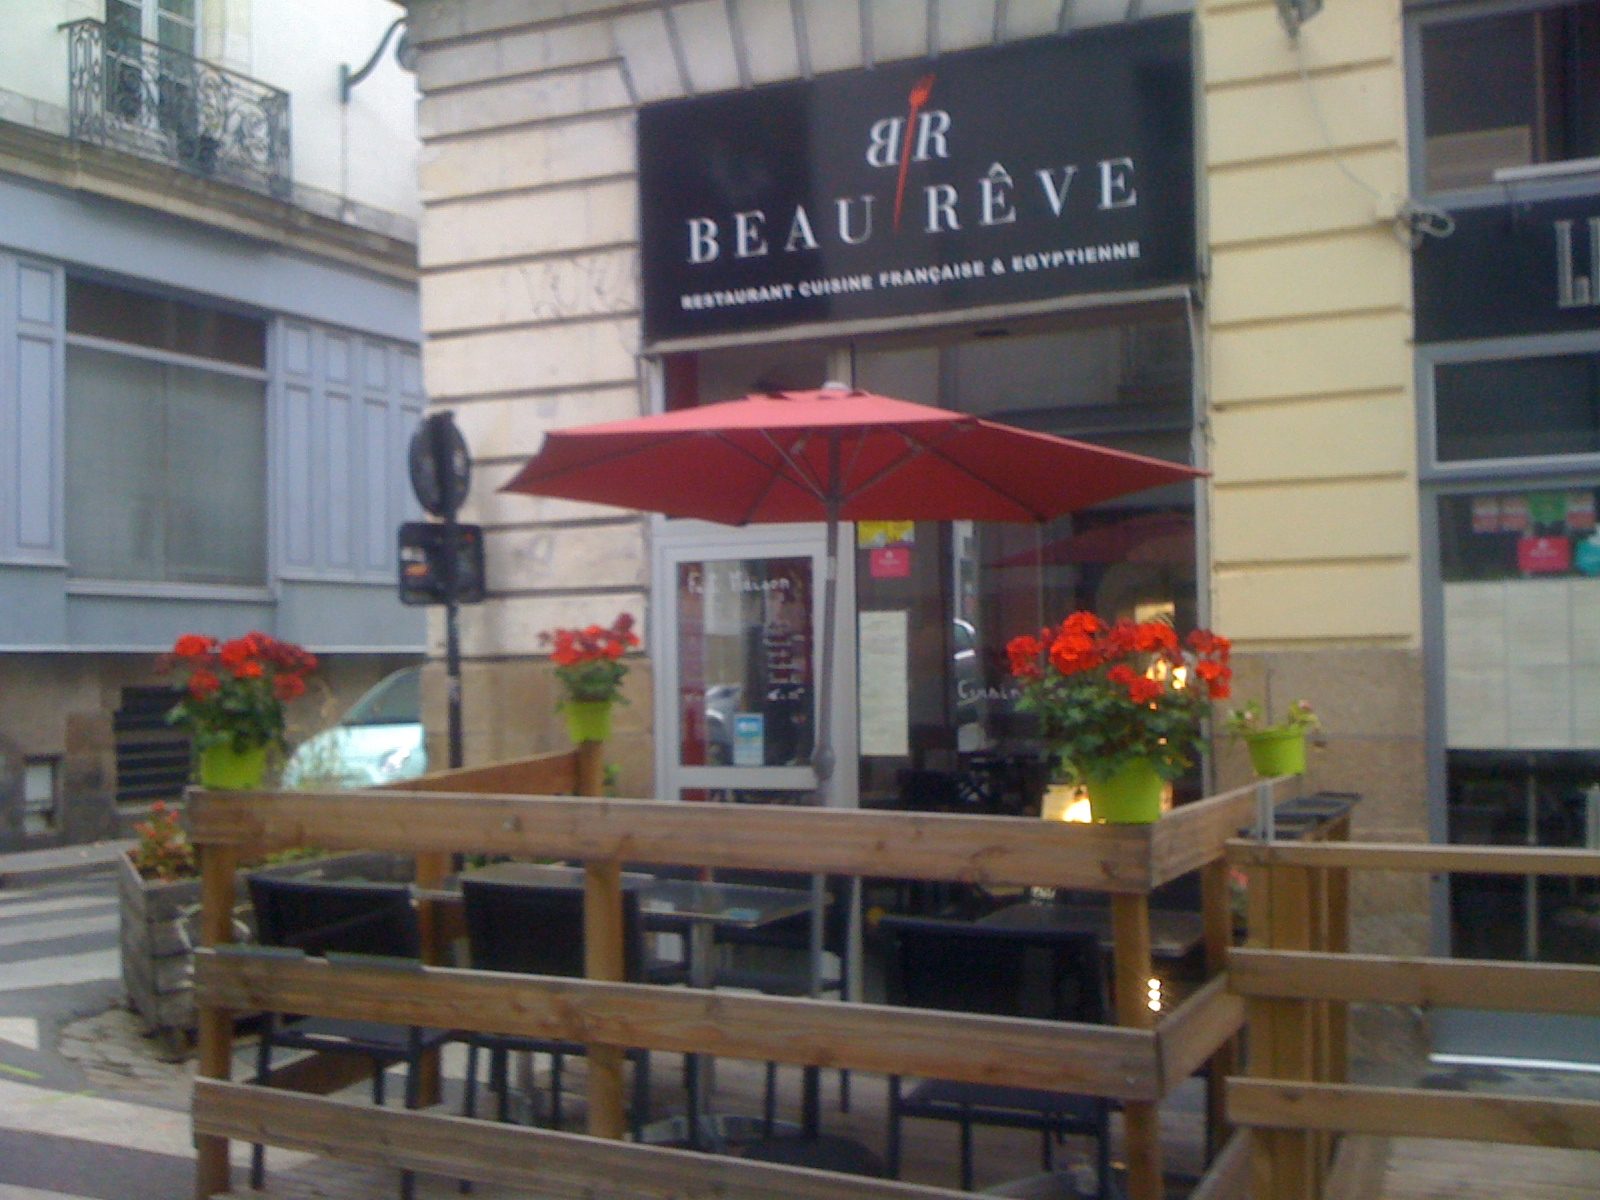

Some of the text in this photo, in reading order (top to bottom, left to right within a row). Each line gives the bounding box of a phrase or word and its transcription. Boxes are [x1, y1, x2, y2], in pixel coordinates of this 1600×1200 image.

[686, 157, 1138, 265] BEAU RÊVE
[680, 240, 1141, 311] RESTAURANT CUISINE FRANÇAISE & EGYPTIENNE
